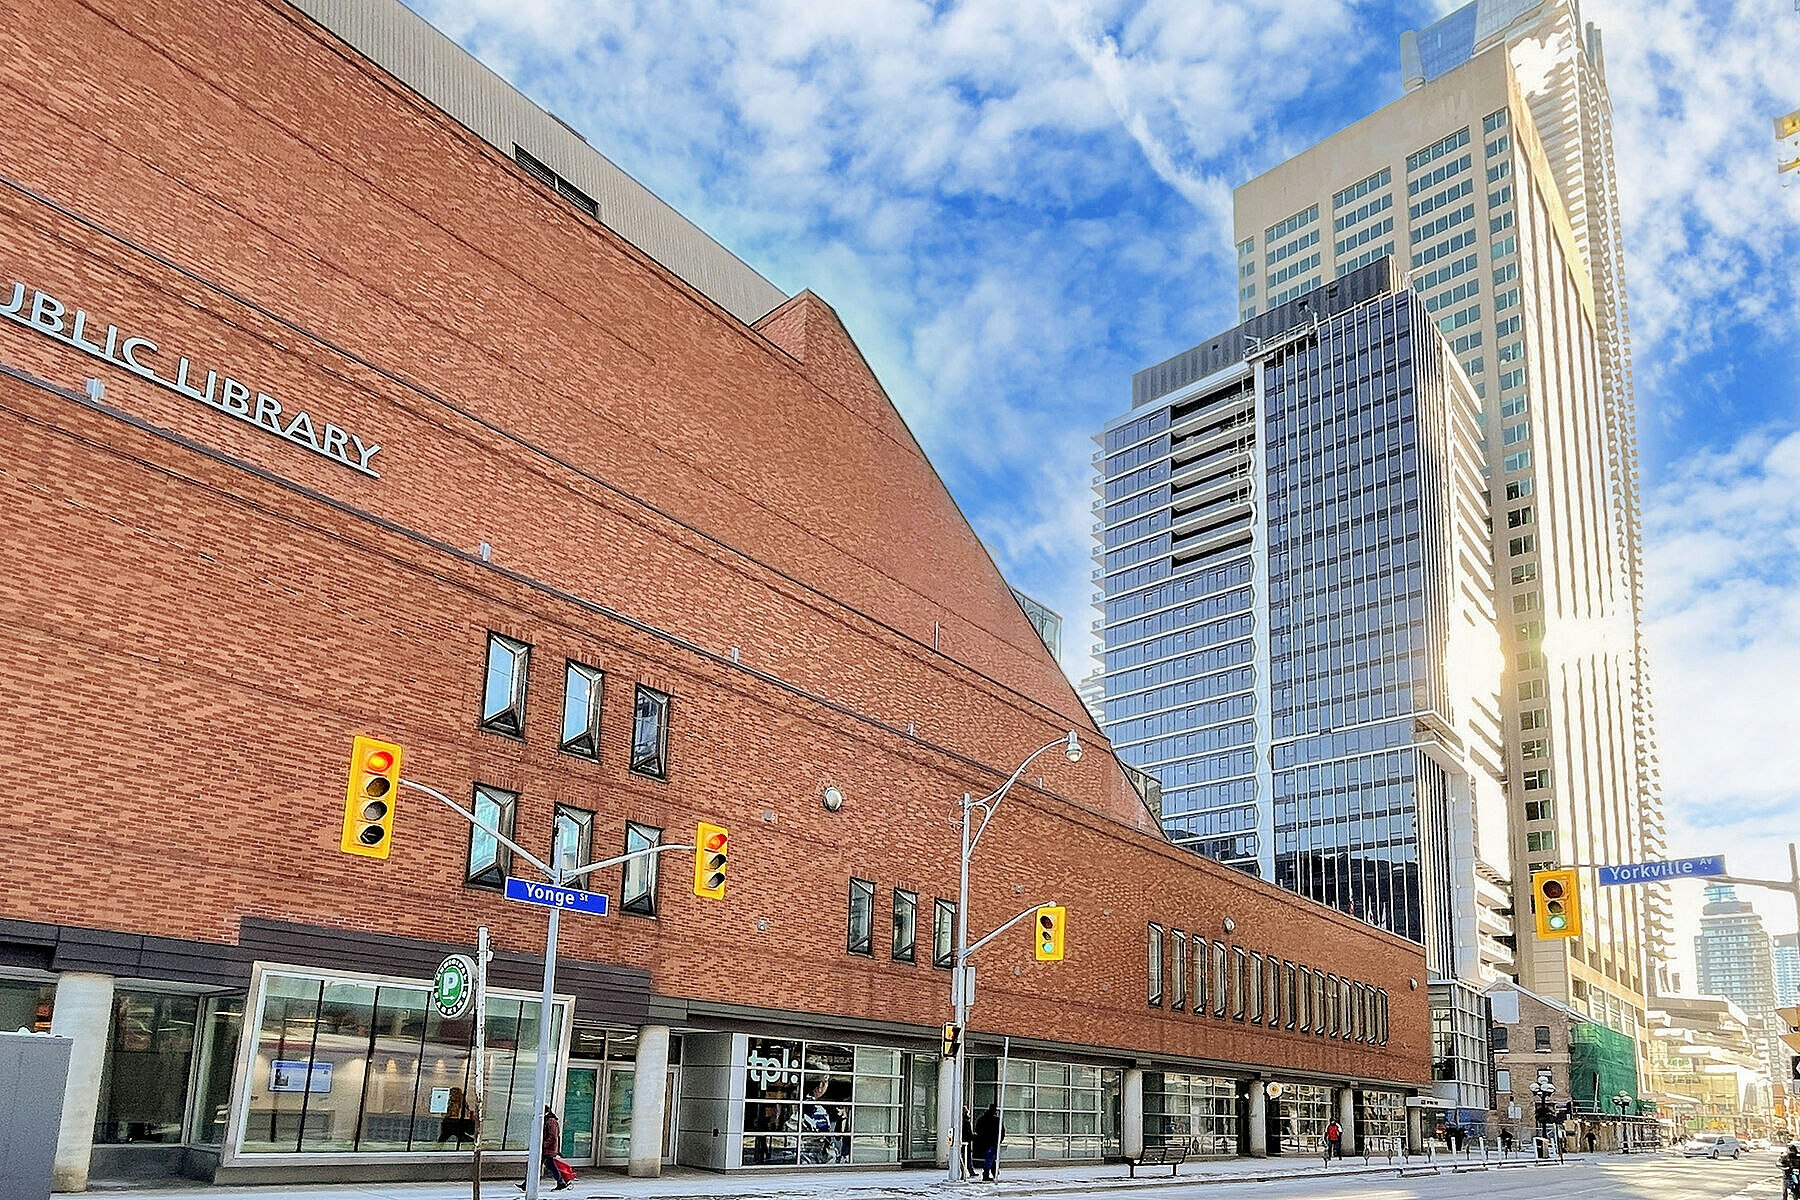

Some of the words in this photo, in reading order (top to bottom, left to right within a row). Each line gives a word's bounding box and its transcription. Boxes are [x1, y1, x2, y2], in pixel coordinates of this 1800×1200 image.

[176, 356, 381, 470] LIBRARY
[1609, 861, 1693, 880] Yorkville
[526, 883, 575, 906] Yonge
[443, 972, 458, 995] P
